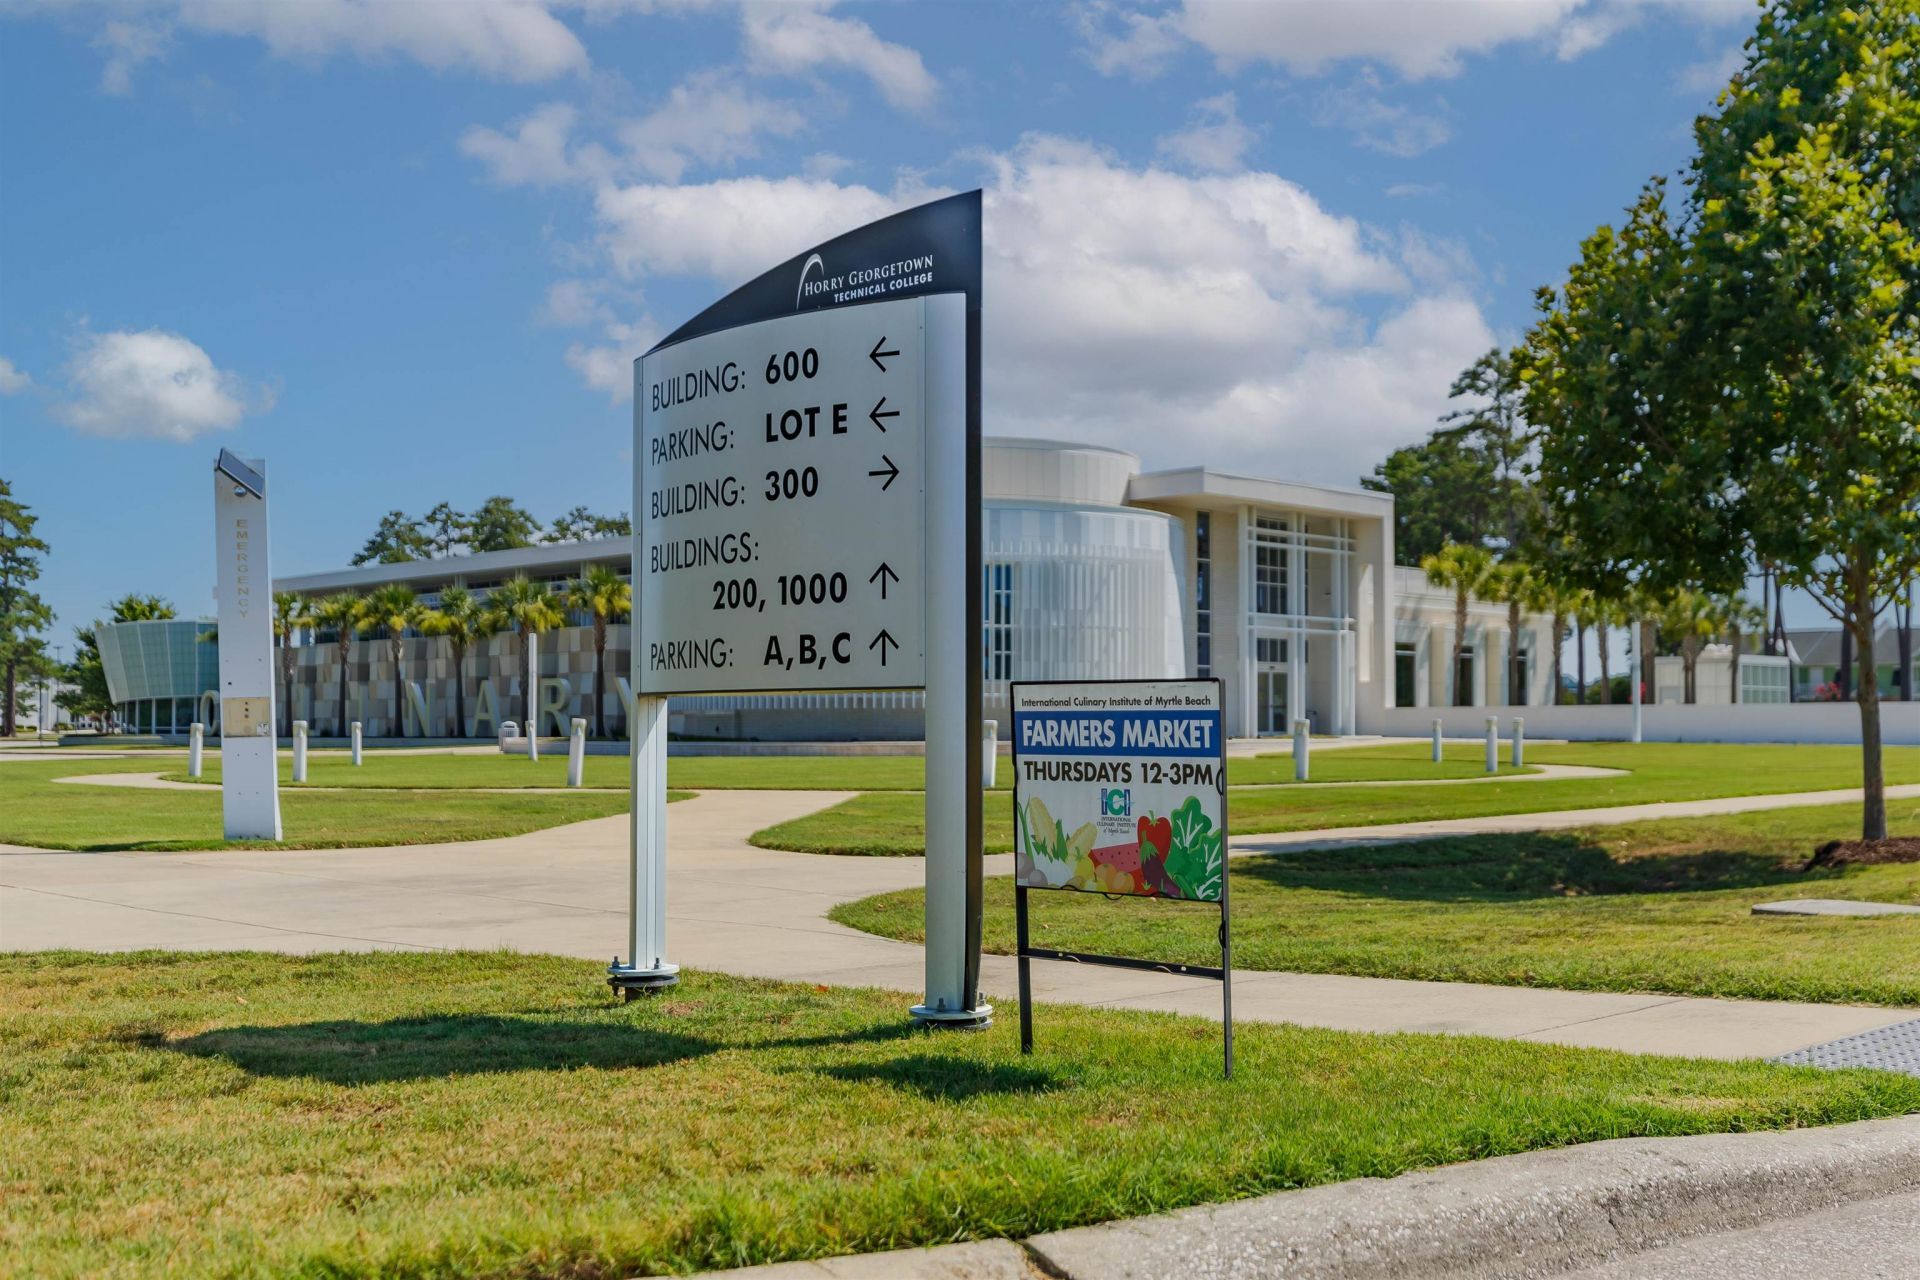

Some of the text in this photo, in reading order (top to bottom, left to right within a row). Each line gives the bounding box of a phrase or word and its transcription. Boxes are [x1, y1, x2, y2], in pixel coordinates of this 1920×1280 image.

[804, 254, 934, 297] HORRY GEORGETOWN
[833, 272, 933, 303] TECHNICAL COLLEGE
[652, 348, 819, 412] BUILDING: 600
[651, 402, 849, 466] PARKING: LOT E
[651, 466, 819, 520] BUILDING: 300
[236, 519, 249, 618] EMERGENCY
[651, 531, 760, 574] BUILDINGS:
[713, 572, 848, 613] 200, 1000
[650, 637, 734, 671] PARKING:
[1021, 695, 1211, 709] International Culinary Institute of Myrtle Beach
[1022, 719, 1213, 748] FARMERS MARKET
[1024, 761, 1213, 785] THURSDAYS 12-3PM
[1101, 788, 1131, 816] ICI
